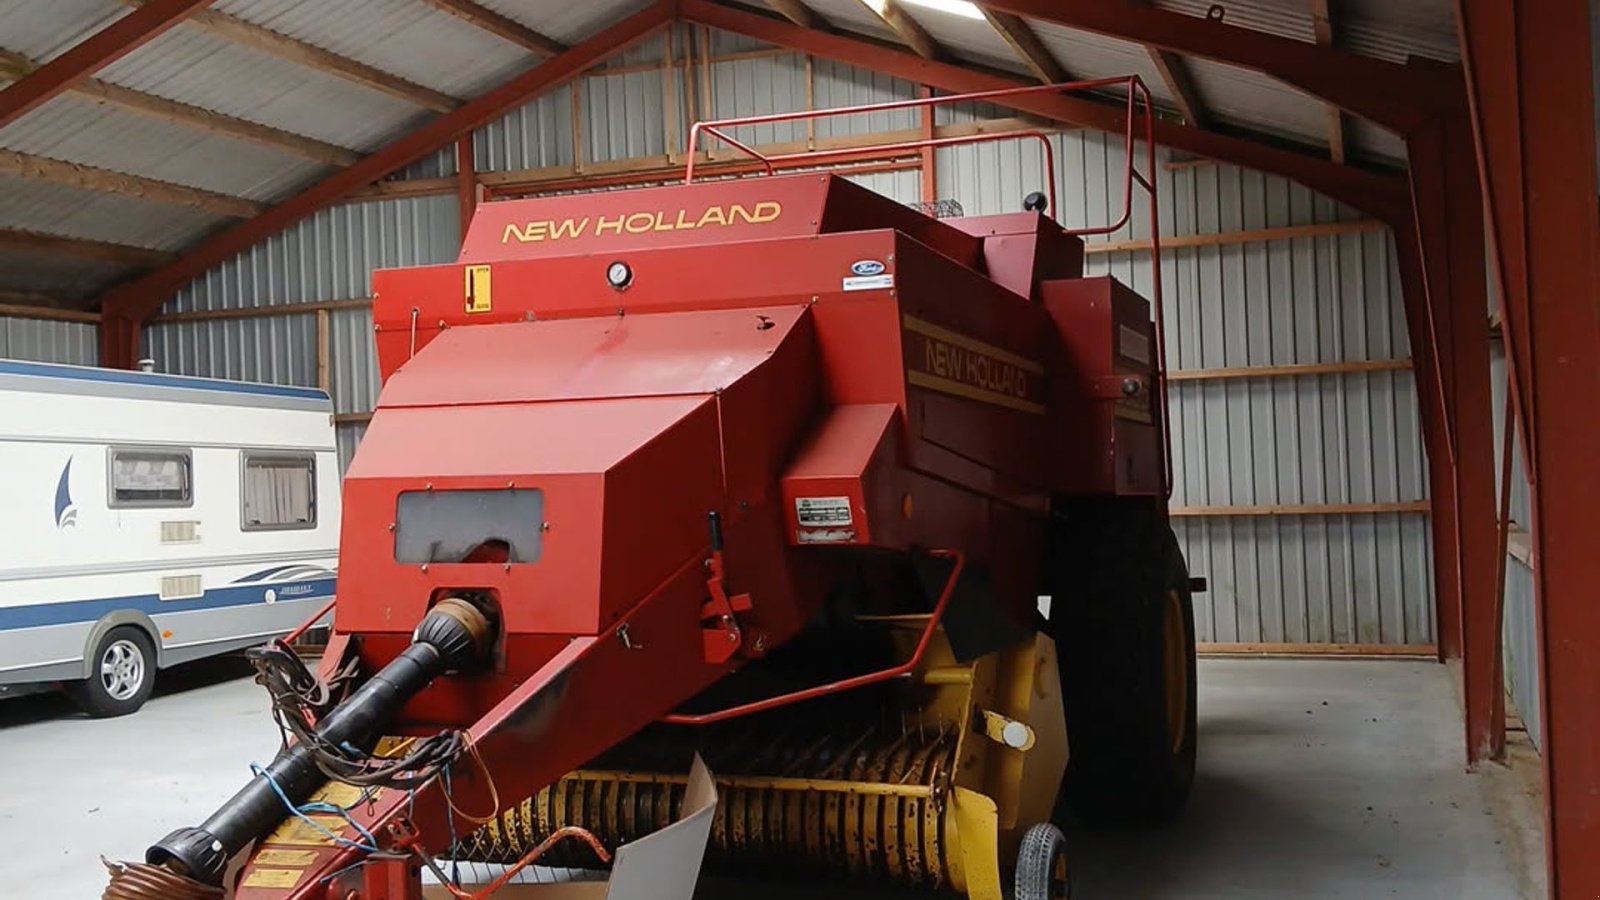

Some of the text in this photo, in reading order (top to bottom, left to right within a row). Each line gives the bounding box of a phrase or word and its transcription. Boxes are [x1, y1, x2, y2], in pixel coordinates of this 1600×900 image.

[501, 200, 783, 244] NEW HOLLAND
[925, 338, 1028, 398] NEW HOLLAND
